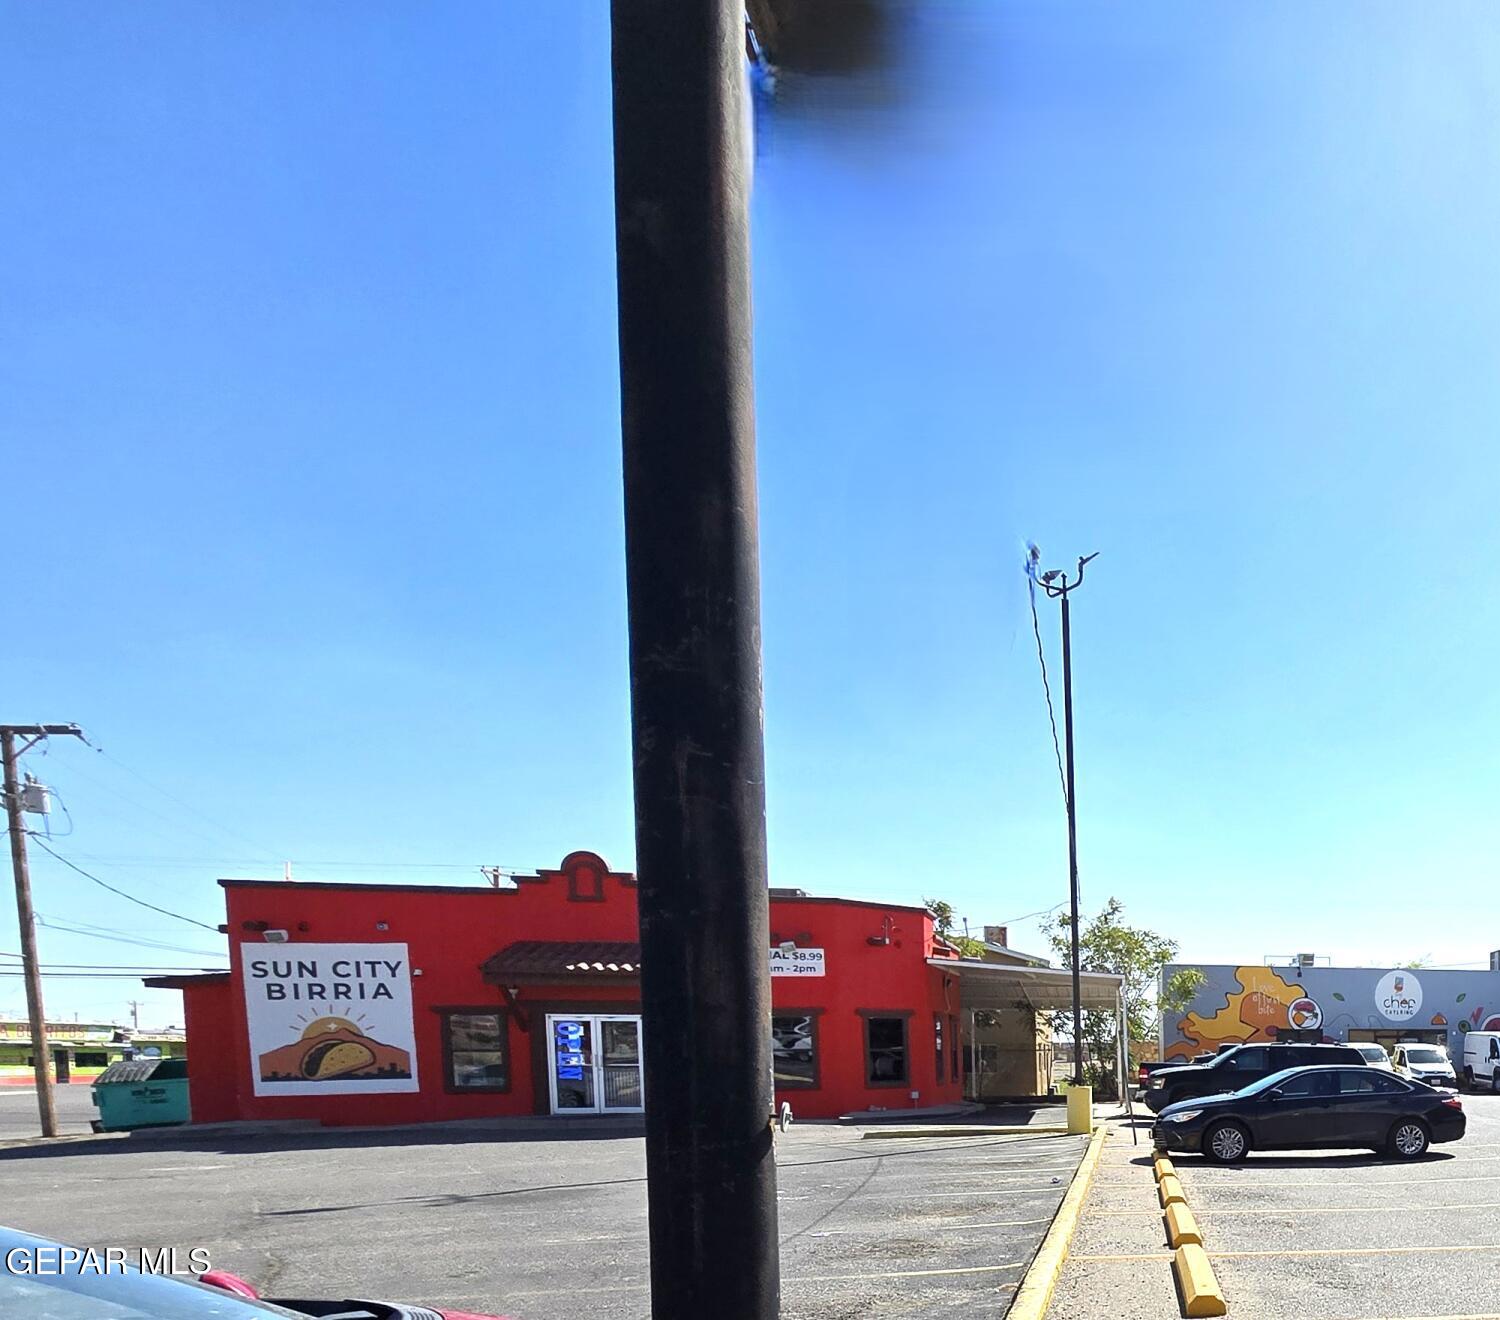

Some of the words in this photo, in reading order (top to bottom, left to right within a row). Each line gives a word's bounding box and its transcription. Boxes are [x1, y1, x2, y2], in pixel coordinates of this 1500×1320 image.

[792, 952, 823, 961] $8.99
[251, 960, 318, 979] SUN
[332, 960, 402, 979] CITY
[793, 965, 817, 973] 2pm
[266, 982, 394, 1000] BIRRIA
[557, 1022, 583, 1081] OPEN
